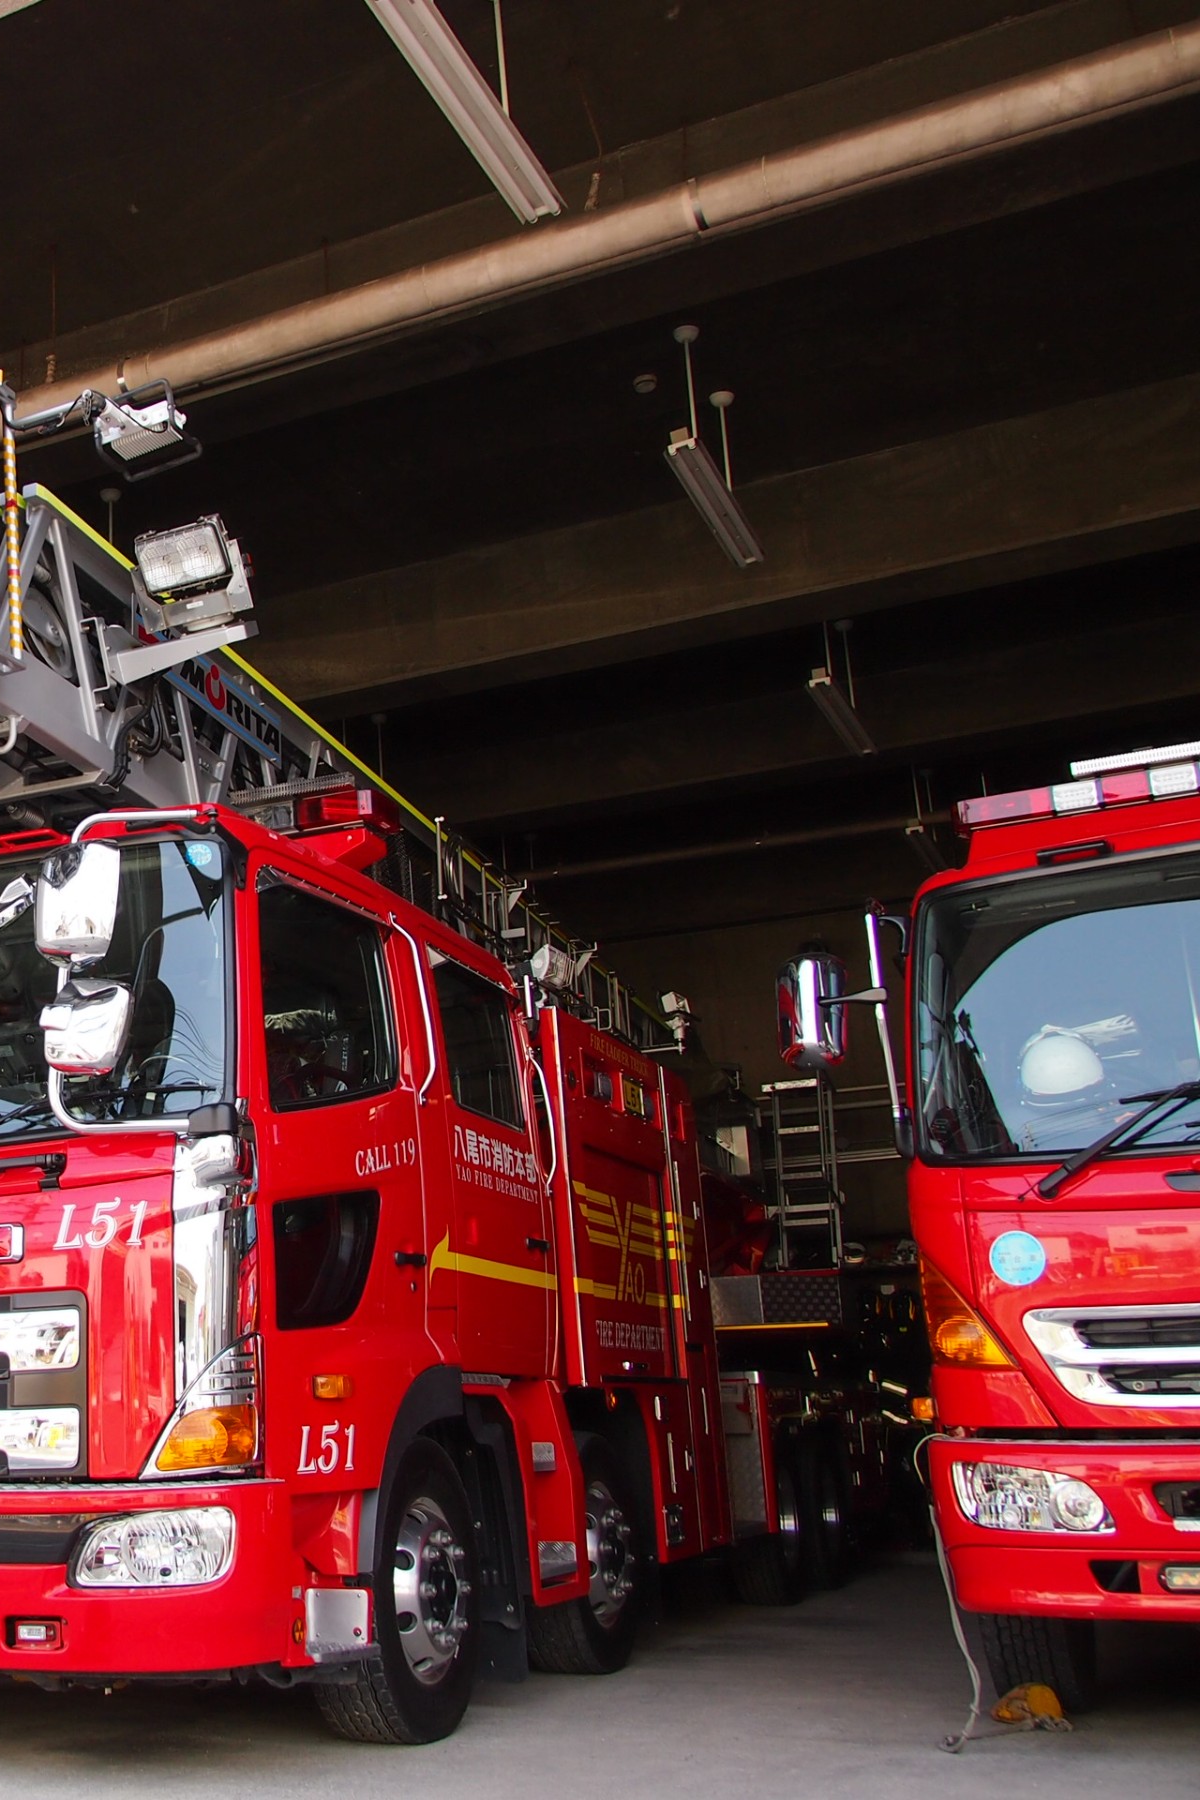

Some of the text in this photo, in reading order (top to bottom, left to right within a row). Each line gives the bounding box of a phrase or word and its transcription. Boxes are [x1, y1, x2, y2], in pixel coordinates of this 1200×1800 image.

[180, 658, 281, 754] MORITA
[355, 1137, 416, 1177] CALL 119
[454, 1124, 537, 1185] 八尾市消防本部
[455, 1163, 539, 1205] YAO FIRE DEPARTMENT
[52, 1196, 148, 1251] L51
[615, 1322, 666, 1352] DEPARTMENT
[296, 1419, 355, 1475] L51
